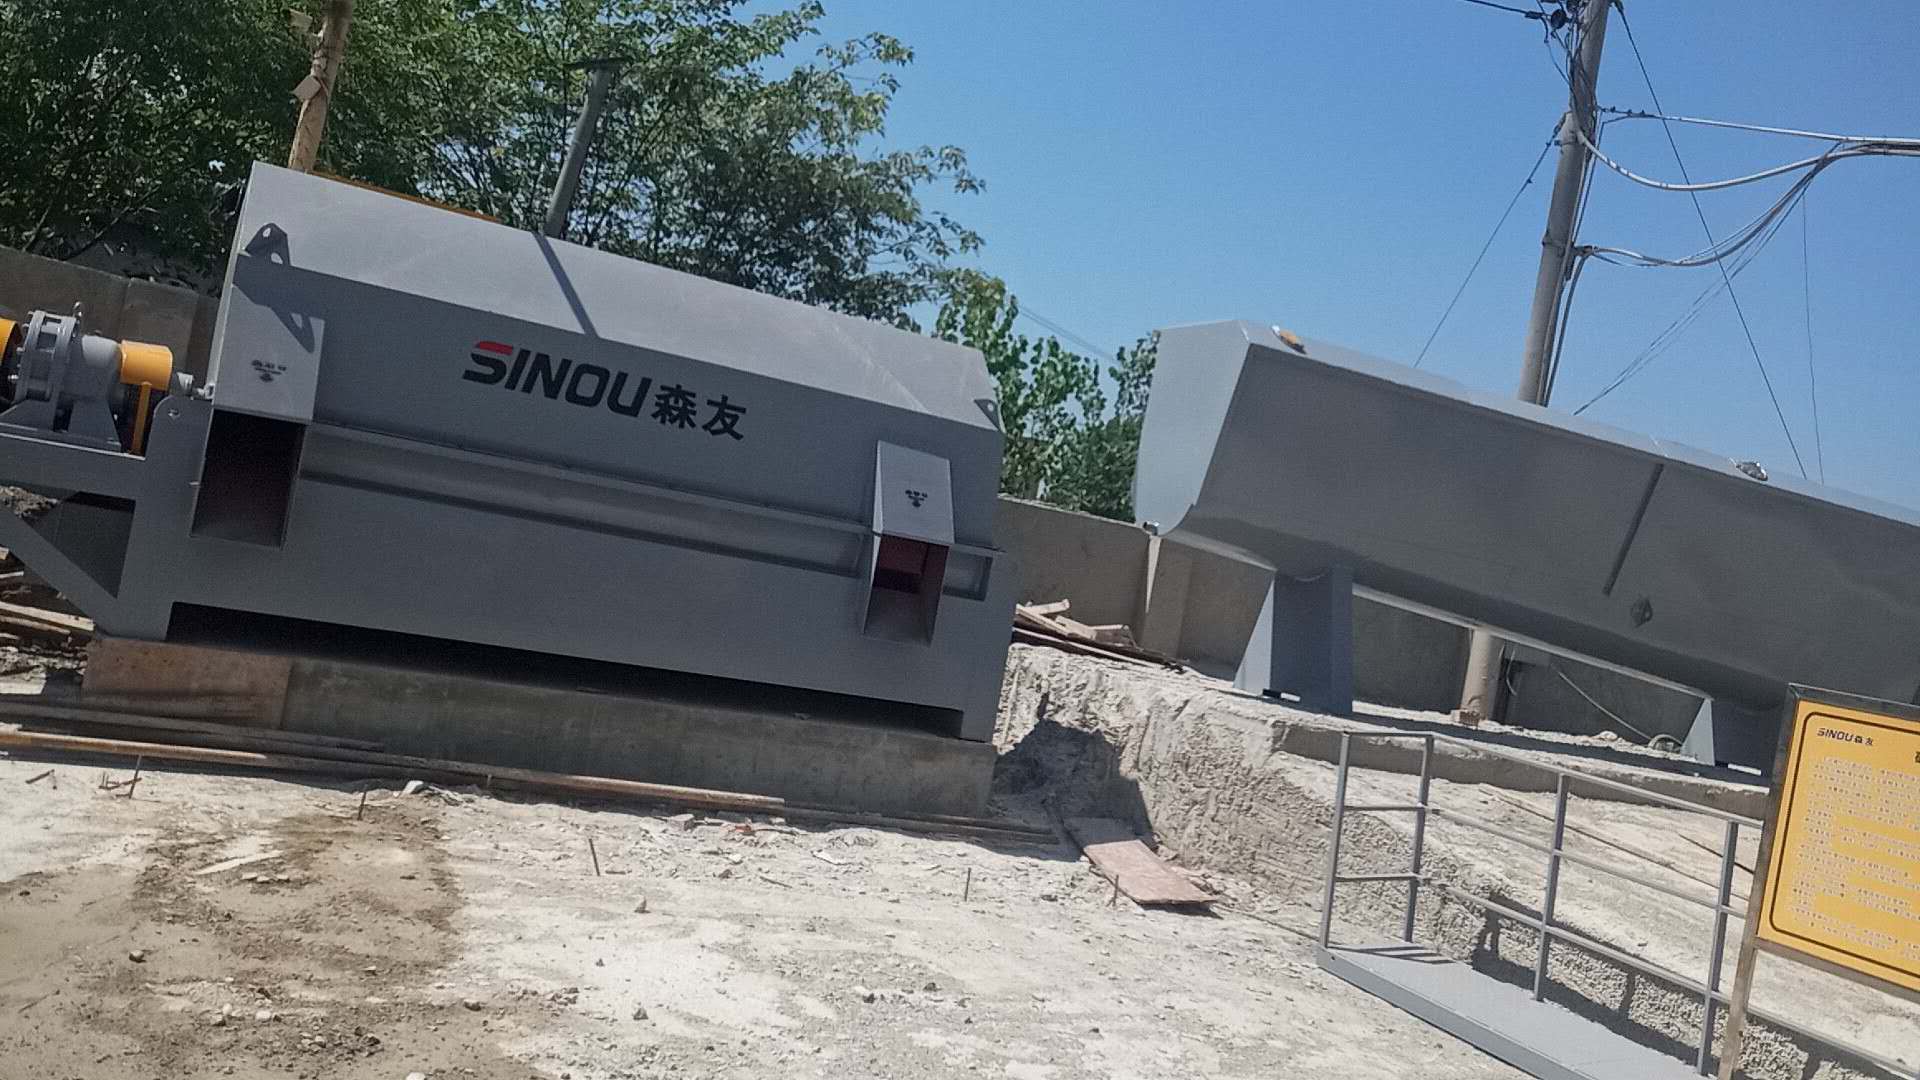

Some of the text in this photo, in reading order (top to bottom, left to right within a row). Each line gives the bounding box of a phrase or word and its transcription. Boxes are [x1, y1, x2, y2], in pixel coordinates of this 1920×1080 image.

[462, 341, 747, 441] SINOU 森友
[1817, 727, 1854, 742] SINOU
